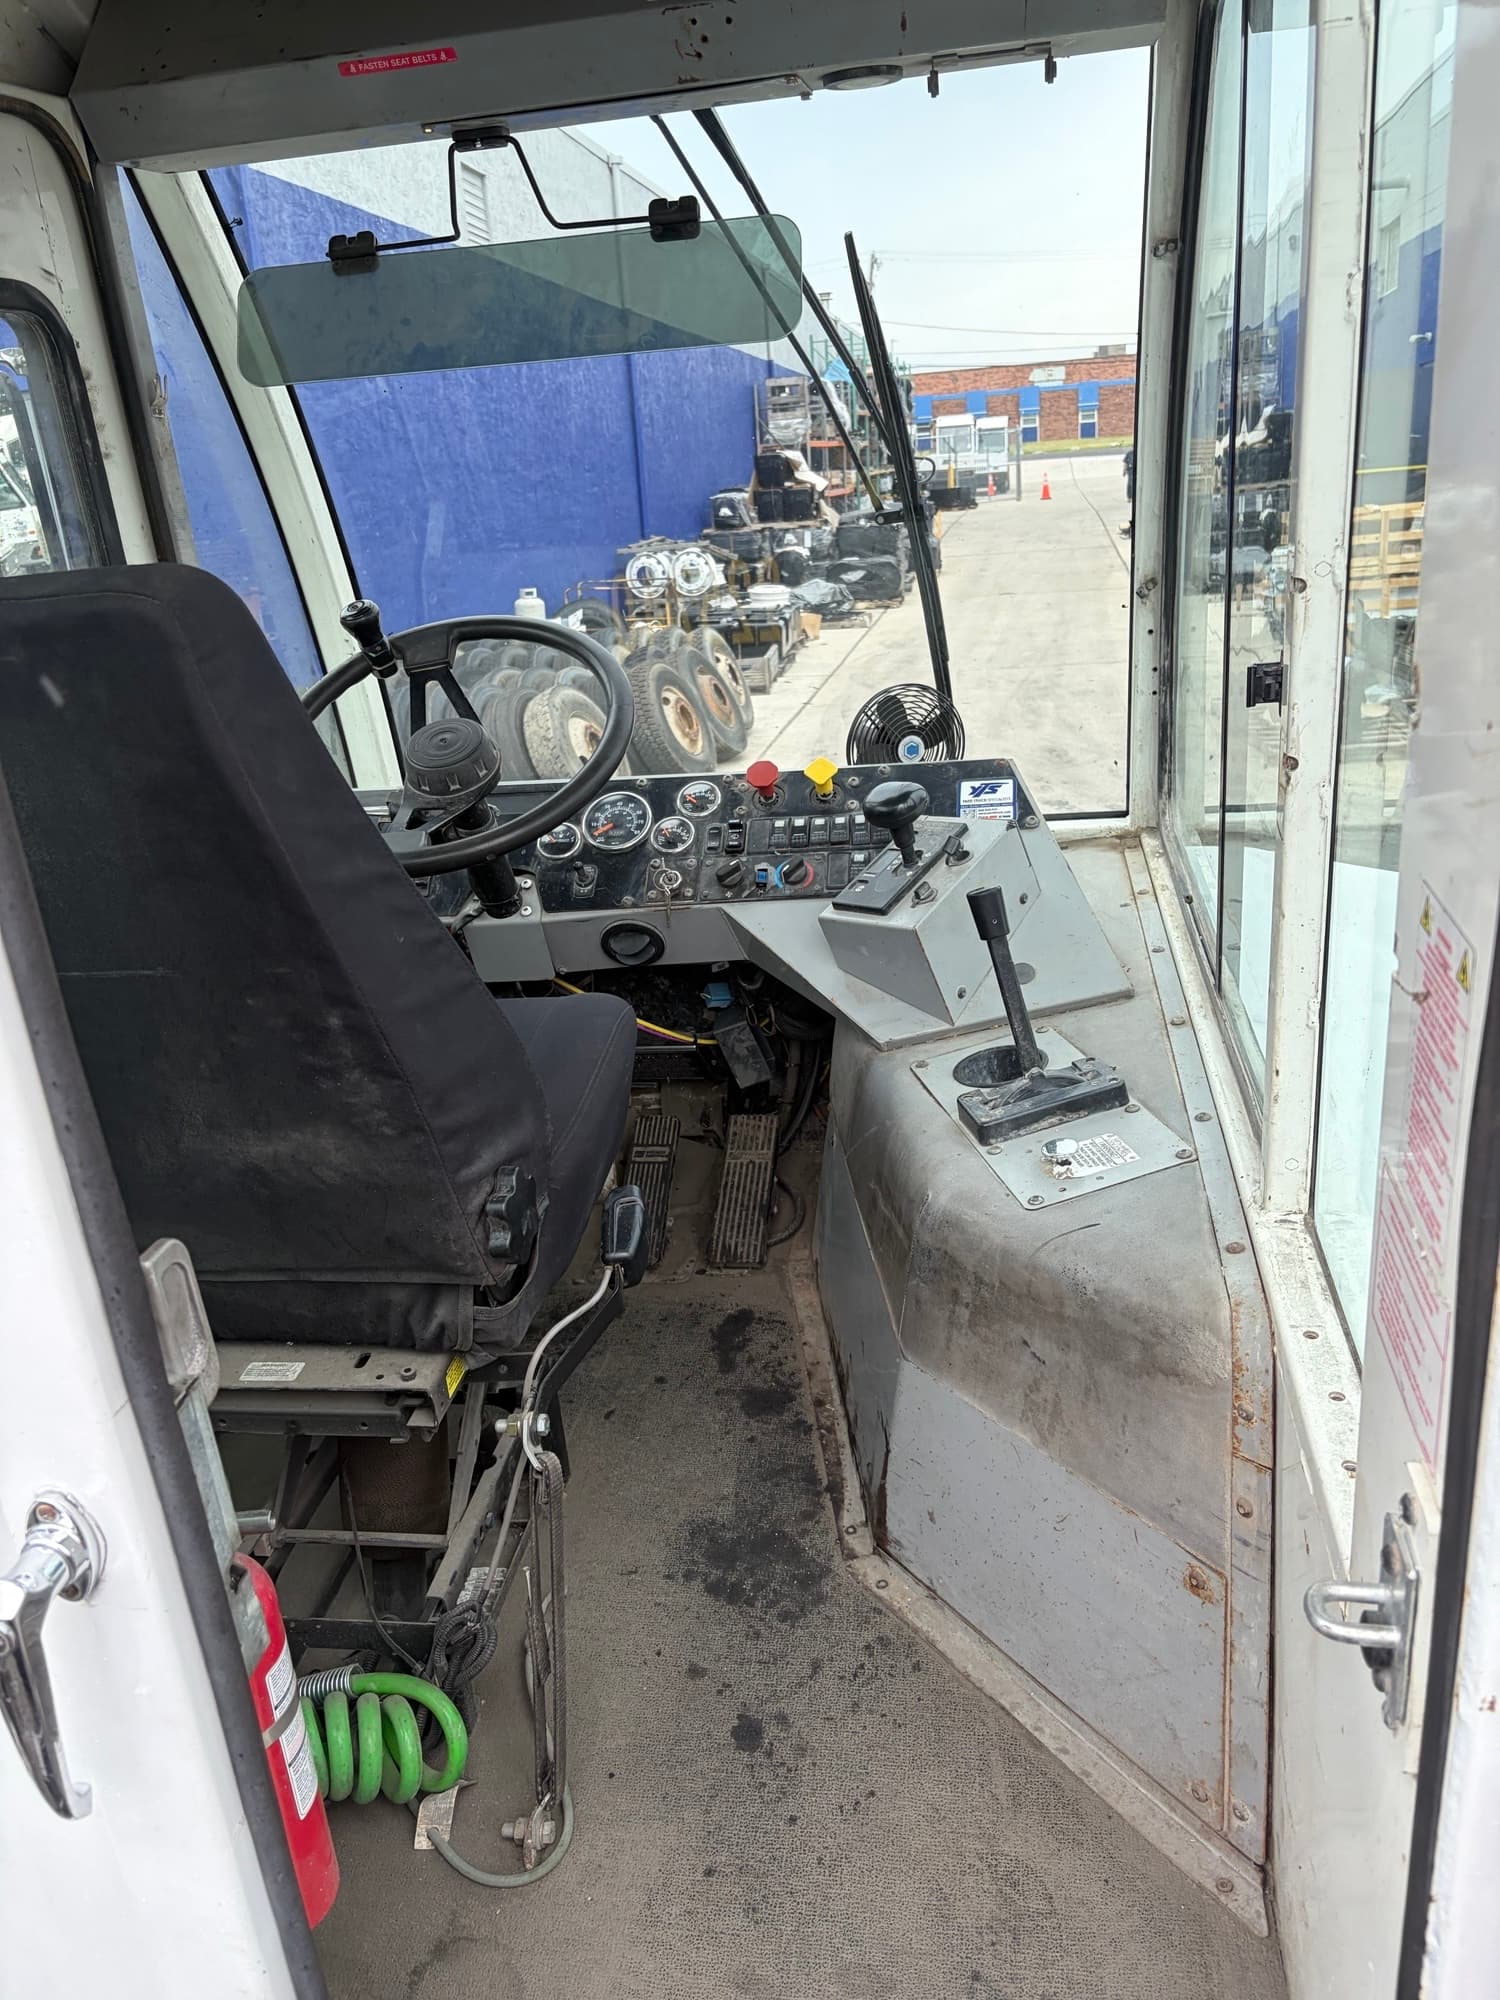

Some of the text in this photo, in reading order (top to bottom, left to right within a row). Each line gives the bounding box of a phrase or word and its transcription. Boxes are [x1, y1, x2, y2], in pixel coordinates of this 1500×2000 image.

[358, 54, 437, 71] FASTEN SEAT BELTS
